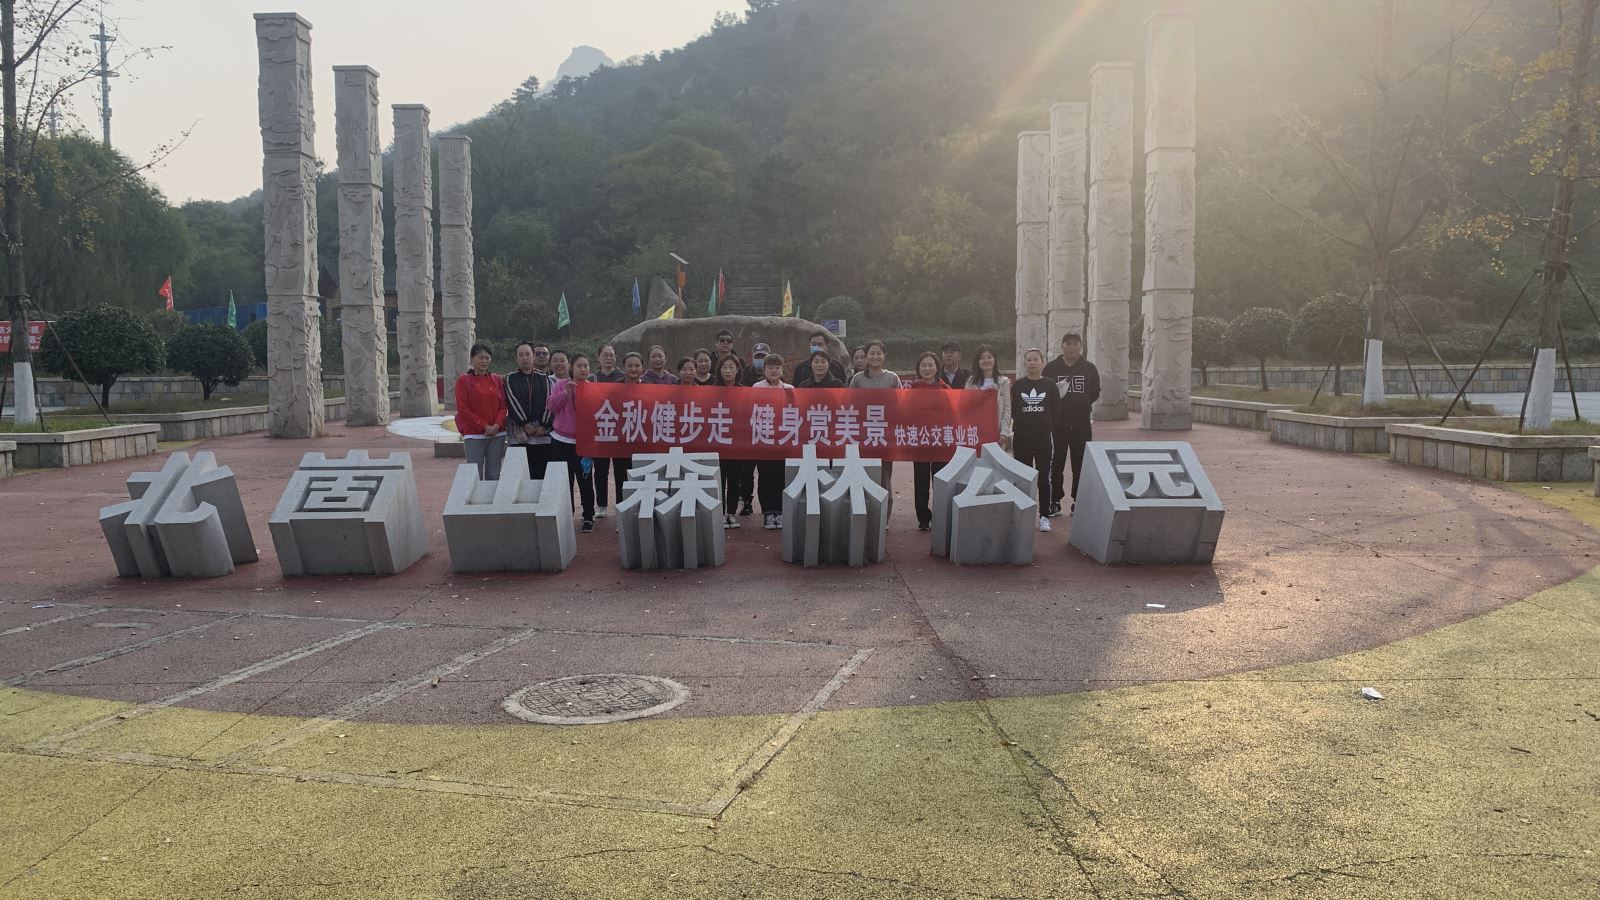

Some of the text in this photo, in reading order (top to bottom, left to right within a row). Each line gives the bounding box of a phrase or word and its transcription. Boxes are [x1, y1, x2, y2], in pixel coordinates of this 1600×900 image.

[594, 399, 980, 446] 金秋健步走 健身赏美景 快速公交事业部
